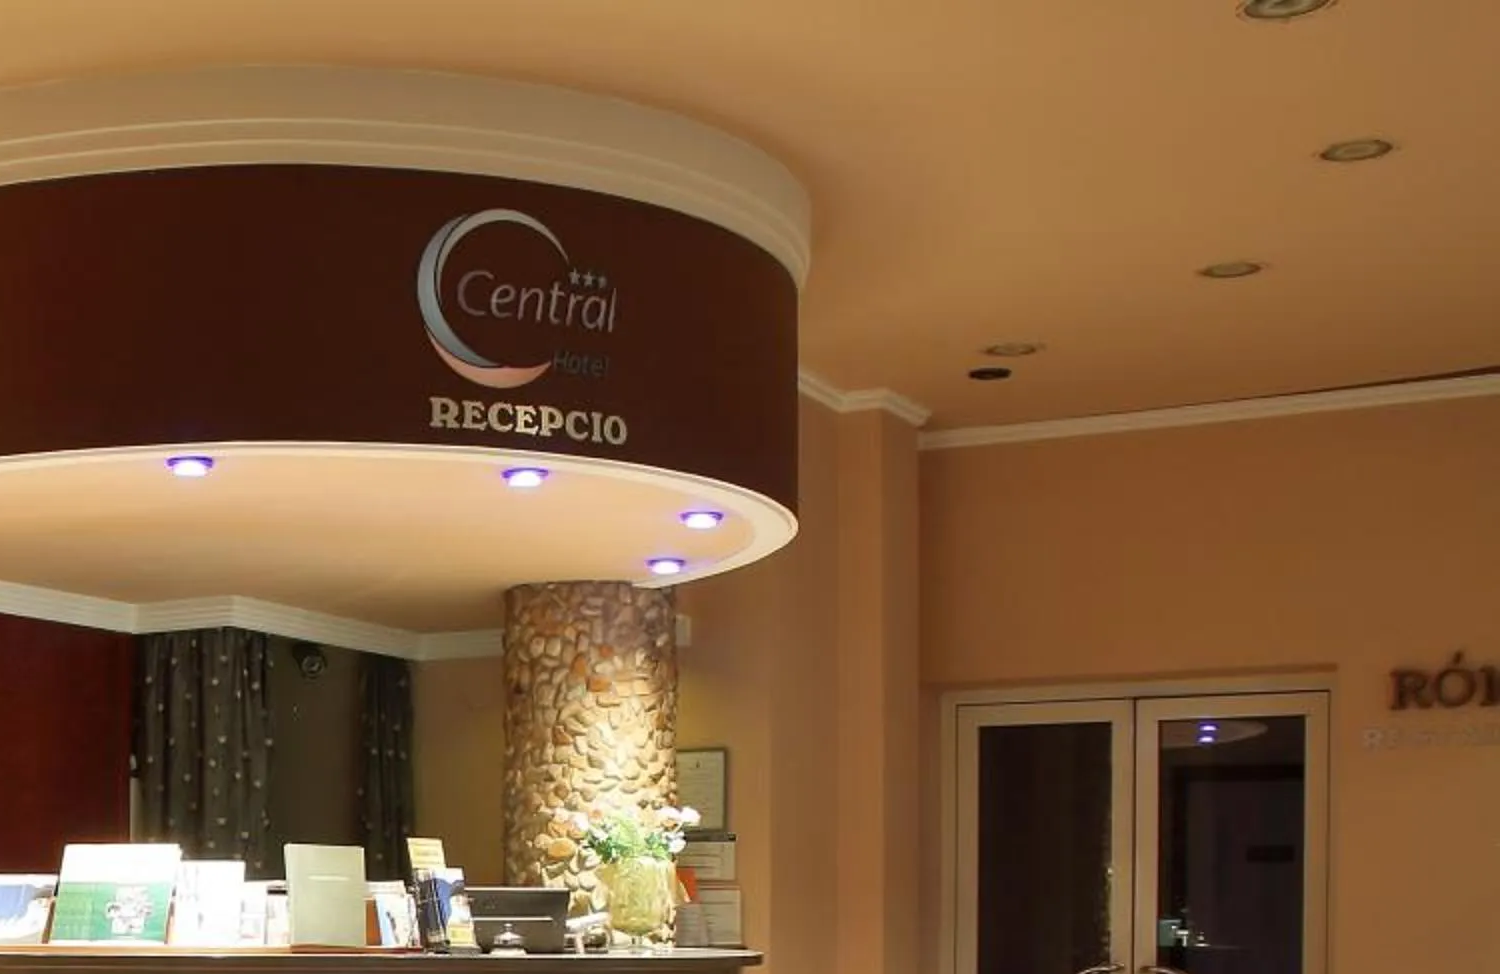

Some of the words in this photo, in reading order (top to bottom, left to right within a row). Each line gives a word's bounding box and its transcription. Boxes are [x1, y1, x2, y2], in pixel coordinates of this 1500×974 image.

[457, 269, 618, 333] Central
[554, 350, 610, 377] Hotel
[429, 396, 629, 445] RECEPCIO
